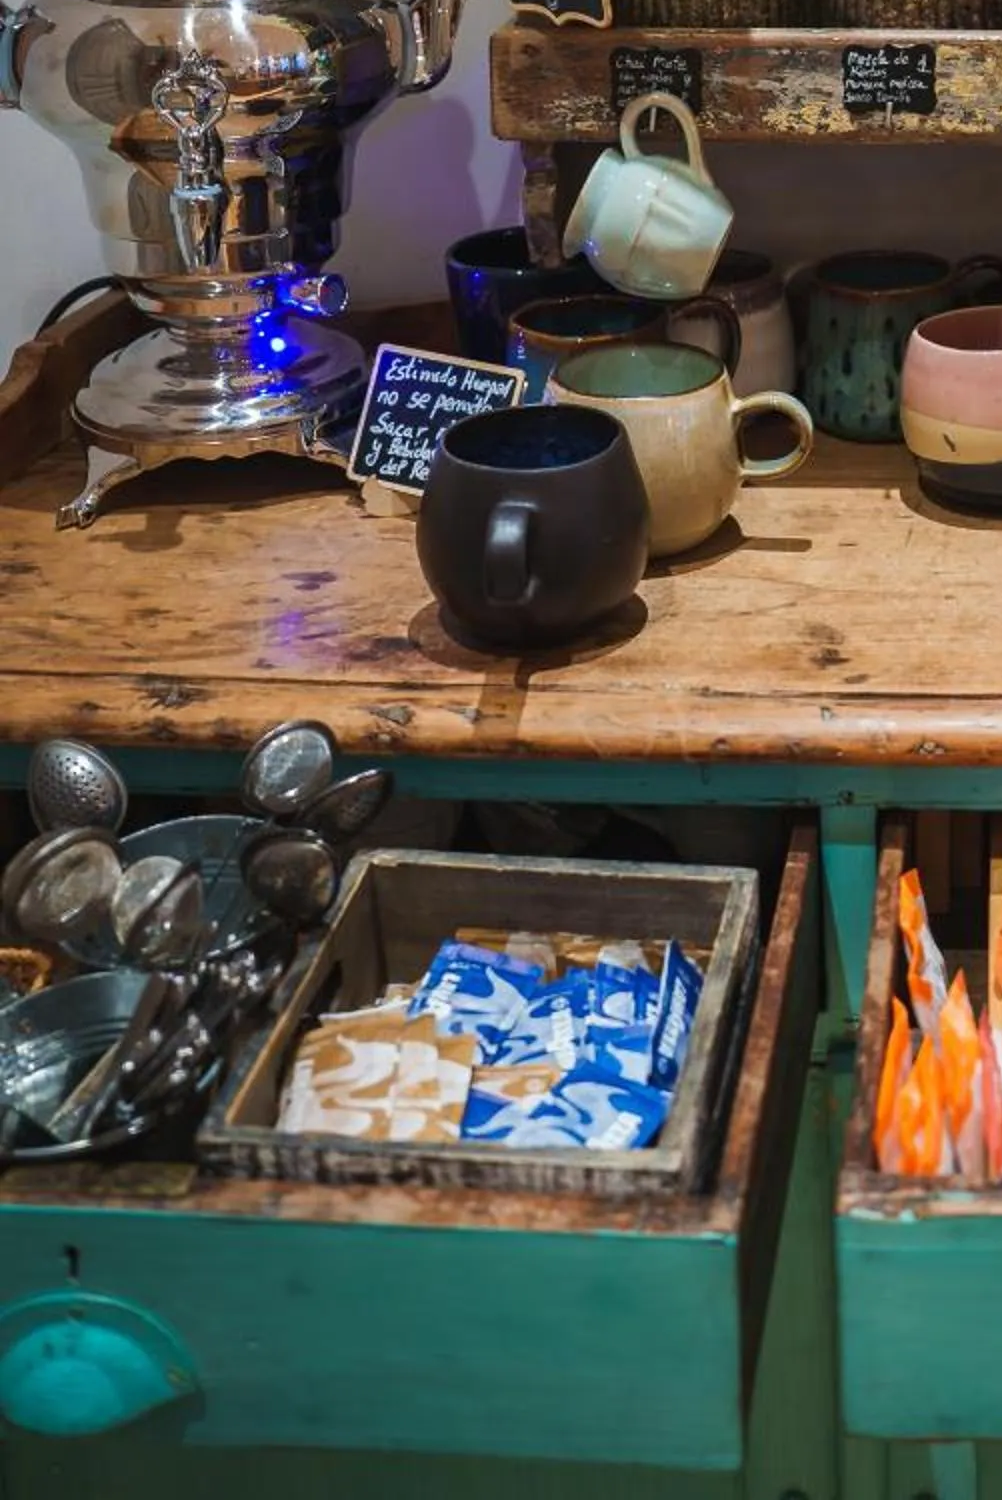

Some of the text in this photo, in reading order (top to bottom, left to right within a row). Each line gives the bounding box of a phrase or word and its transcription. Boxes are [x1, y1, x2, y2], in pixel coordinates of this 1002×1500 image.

[385, 357, 458, 388] Estimado
[377, 391, 399, 406] no
[405, 391, 432, 410] se
[365, 437, 383, 467] y
